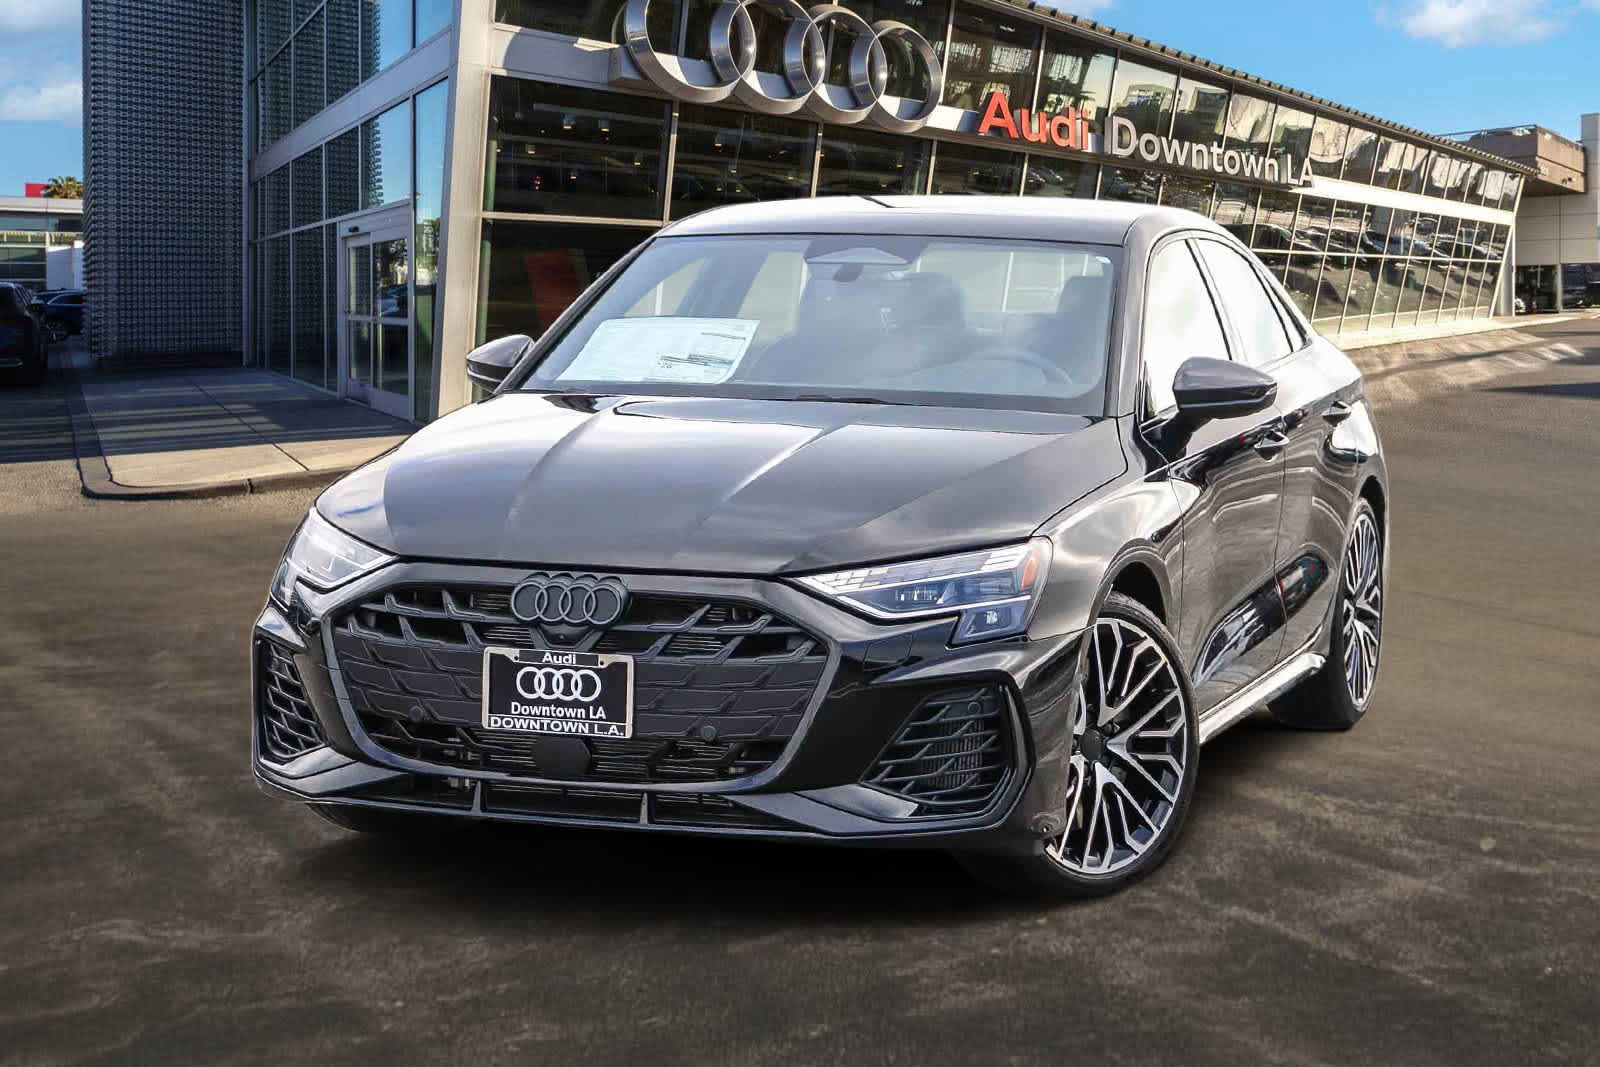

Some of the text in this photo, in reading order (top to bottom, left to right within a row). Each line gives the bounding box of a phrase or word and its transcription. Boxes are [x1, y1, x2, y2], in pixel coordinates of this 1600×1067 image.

[978, 91, 1314, 187] Audi Downtown LA
[542, 652, 576, 665] Audi
[511, 701, 607, 720] Downtown LA
[490, 716, 624, 736] DOWNTOWN L.A.
